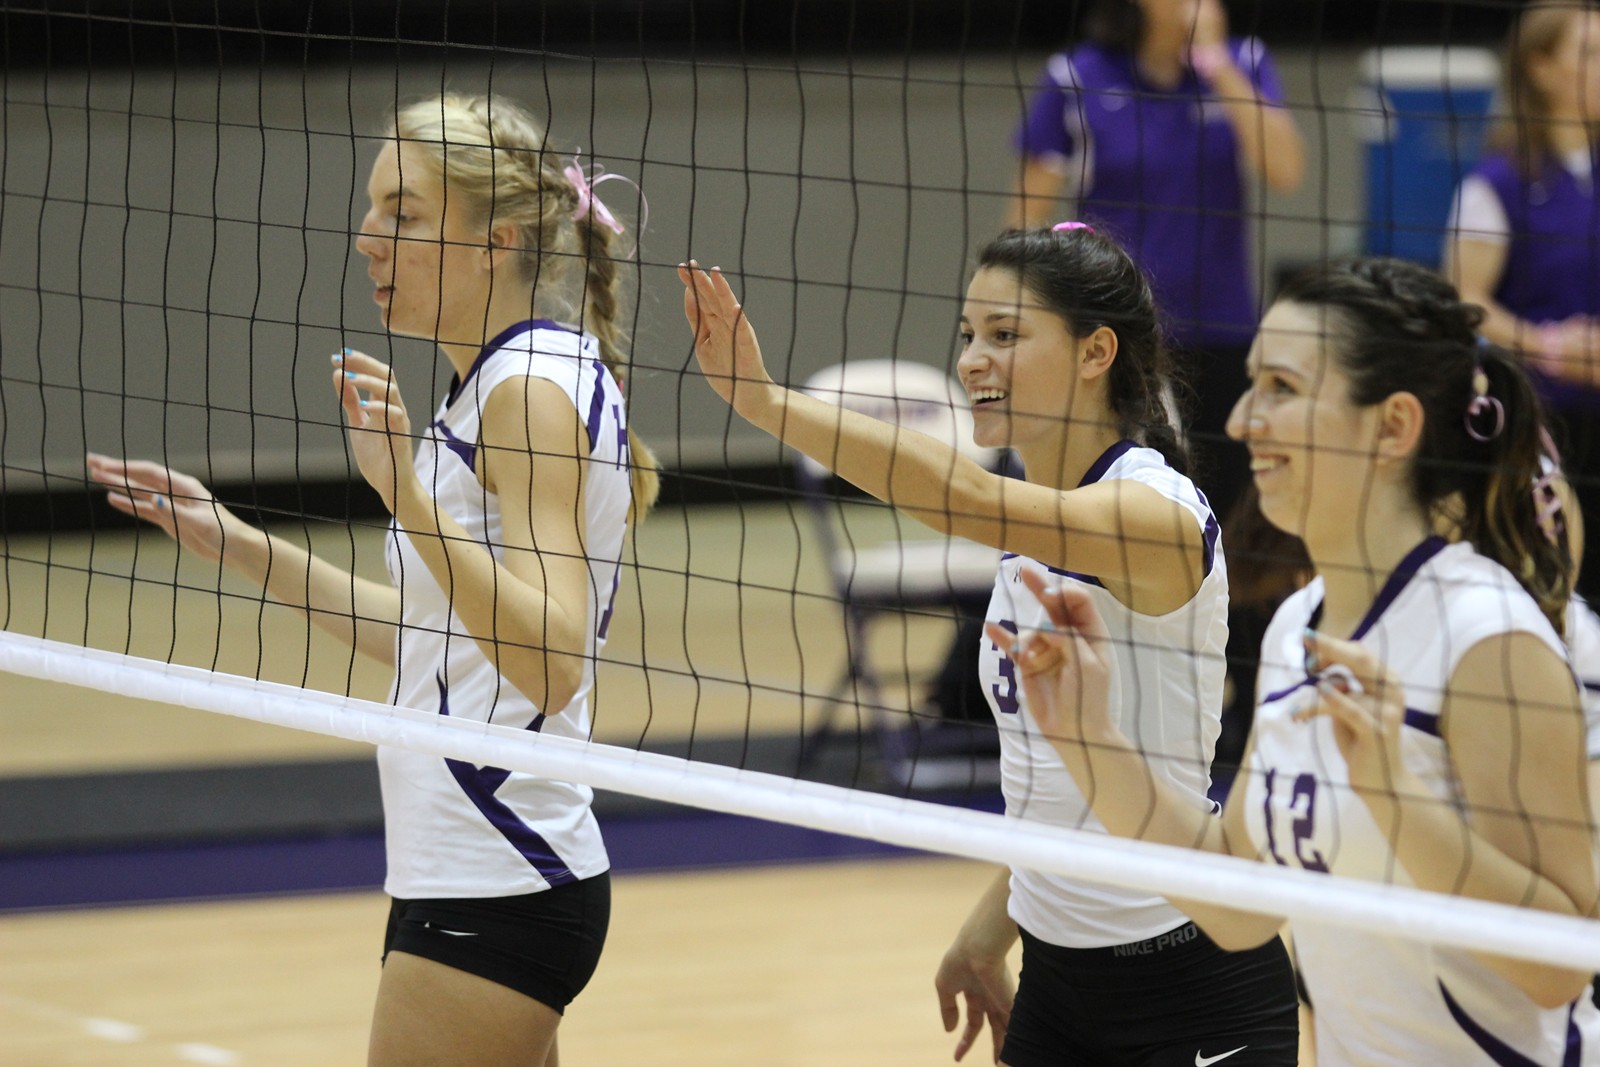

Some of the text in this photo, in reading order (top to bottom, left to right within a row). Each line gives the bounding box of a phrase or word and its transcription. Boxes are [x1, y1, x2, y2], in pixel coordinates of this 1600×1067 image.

[991, 619, 1020, 714] 3
[1263, 767, 1330, 874] 12
[1113, 924, 1198, 957] NIKE PRO
